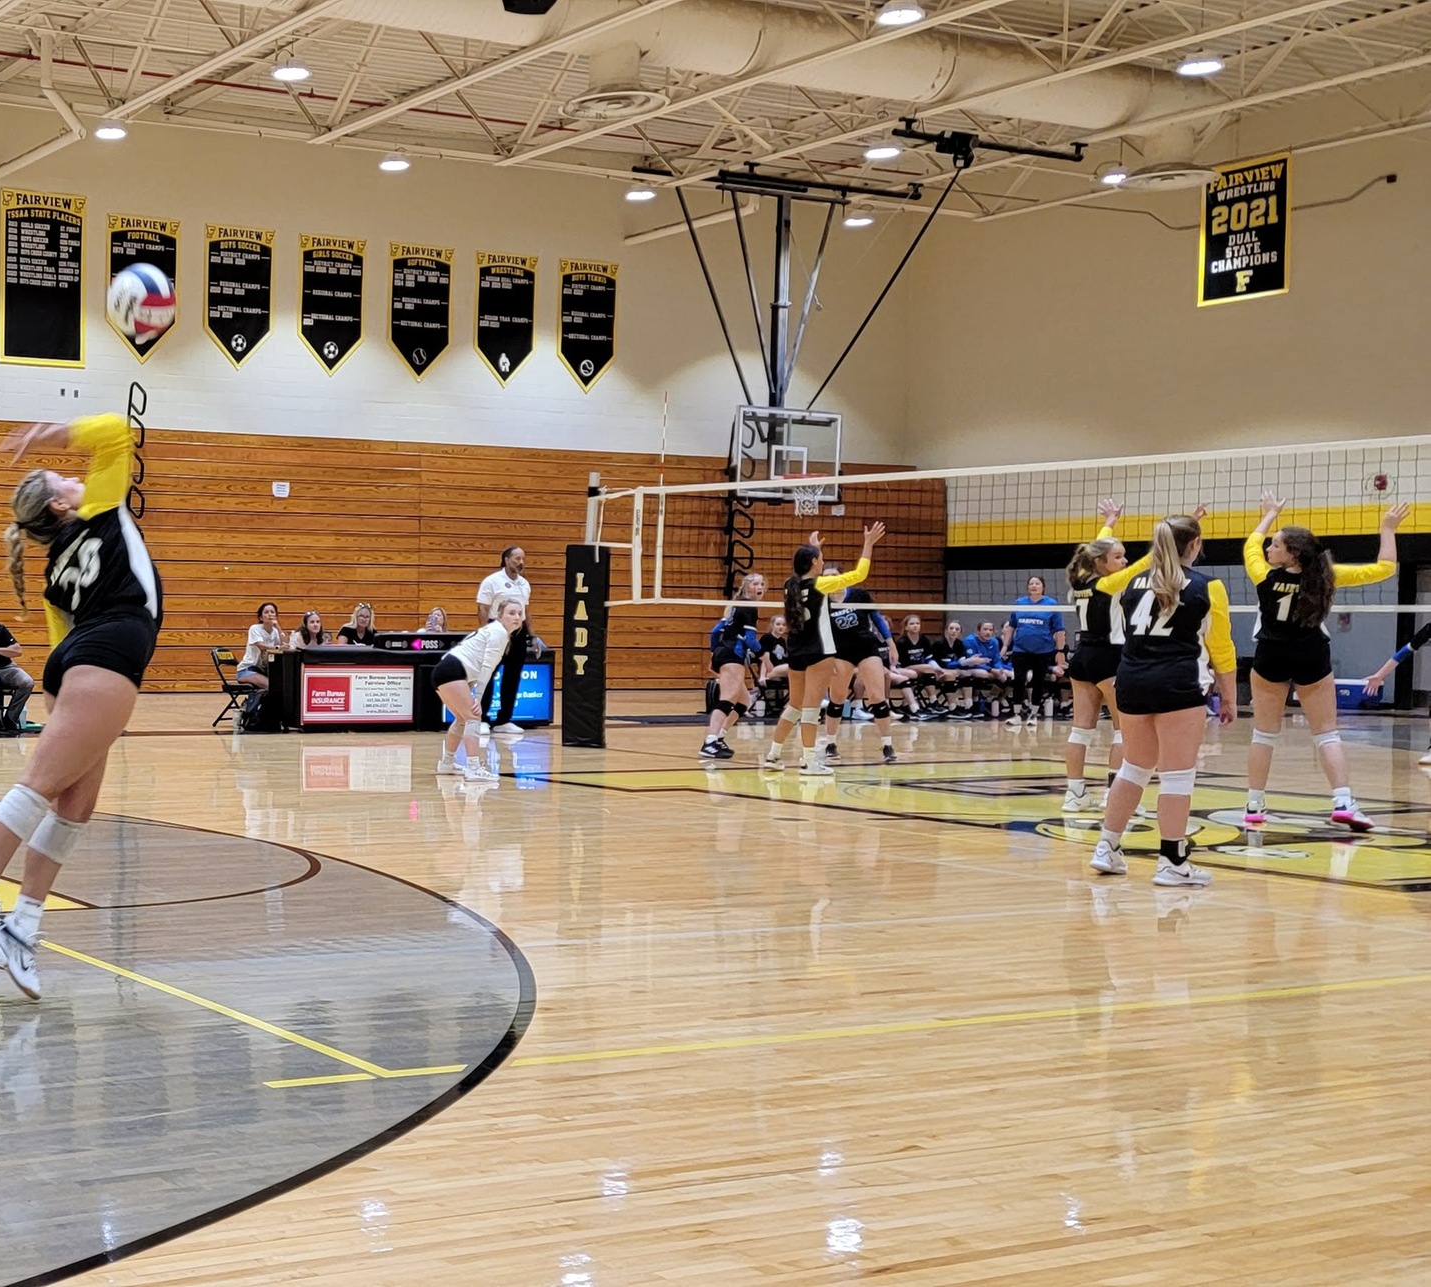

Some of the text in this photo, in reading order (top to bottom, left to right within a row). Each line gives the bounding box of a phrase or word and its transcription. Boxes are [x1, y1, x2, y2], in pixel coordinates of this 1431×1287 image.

[1209, 162, 1285, 194] FAIRVIEW
[1217, 181, 1275, 202] WRESTLING
[16, 193, 71, 209] FAIRVIEW
[7, 209, 81, 226] TSSAA STATE PLACERS
[1211, 194, 1279, 236] 2021
[120, 217, 167, 232] FAIRVIEW
[127, 232, 160, 242] FOOTBALL
[218, 227, 263, 241] FAIRVIEW
[1228, 230, 1258, 246] DUAL
[220, 241, 260, 252] BOYS SOCCER
[312, 237, 354, 251] FAIRVIEW
[1225, 242, 1261, 259] STATE
[331, 250, 353, 261] SOCCER
[401, 246, 443, 259] FAIRVIEW
[407, 259, 436, 269] SOFTBALL
[487, 254, 527, 267] FAIRVIEW
[570, 262, 608, 274] FAIRVIEW
[1211, 251, 1278, 274] CHAMPIONS
[491, 267, 524, 277] WRESTLING
[1235, 269, 1253, 293] F
[573, 572, 589, 675] LADY
[835, 613, 859, 630] 22
[421, 640, 439, 649] POSS
